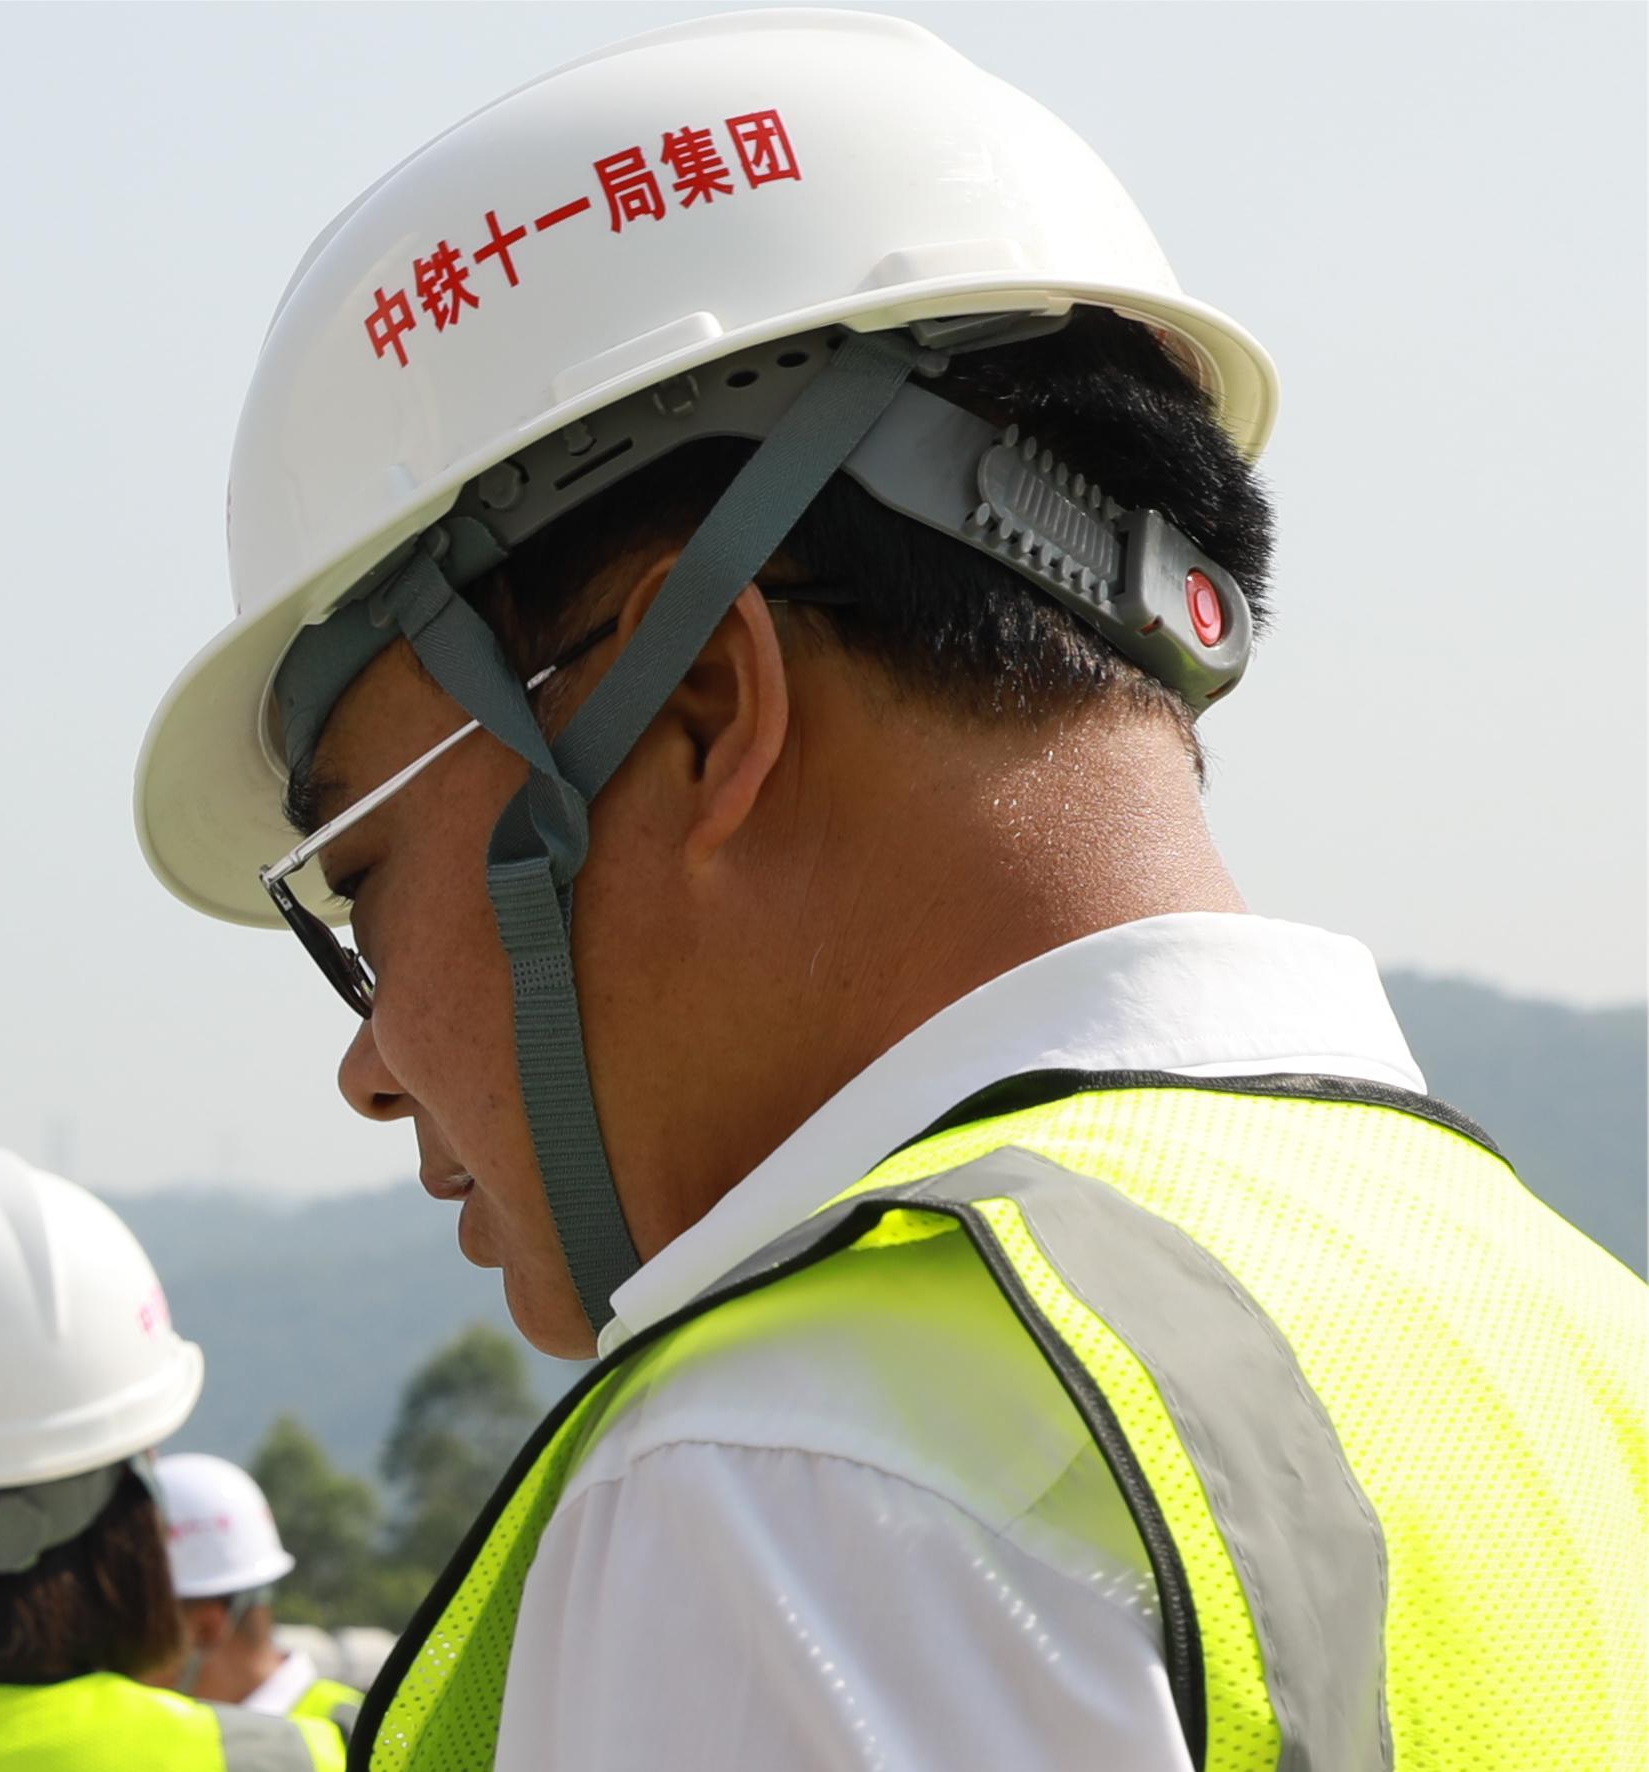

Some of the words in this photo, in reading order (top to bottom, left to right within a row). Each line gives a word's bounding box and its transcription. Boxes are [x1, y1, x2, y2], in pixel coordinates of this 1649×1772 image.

[363, 108, 803, 367] 中铁十一局集团
